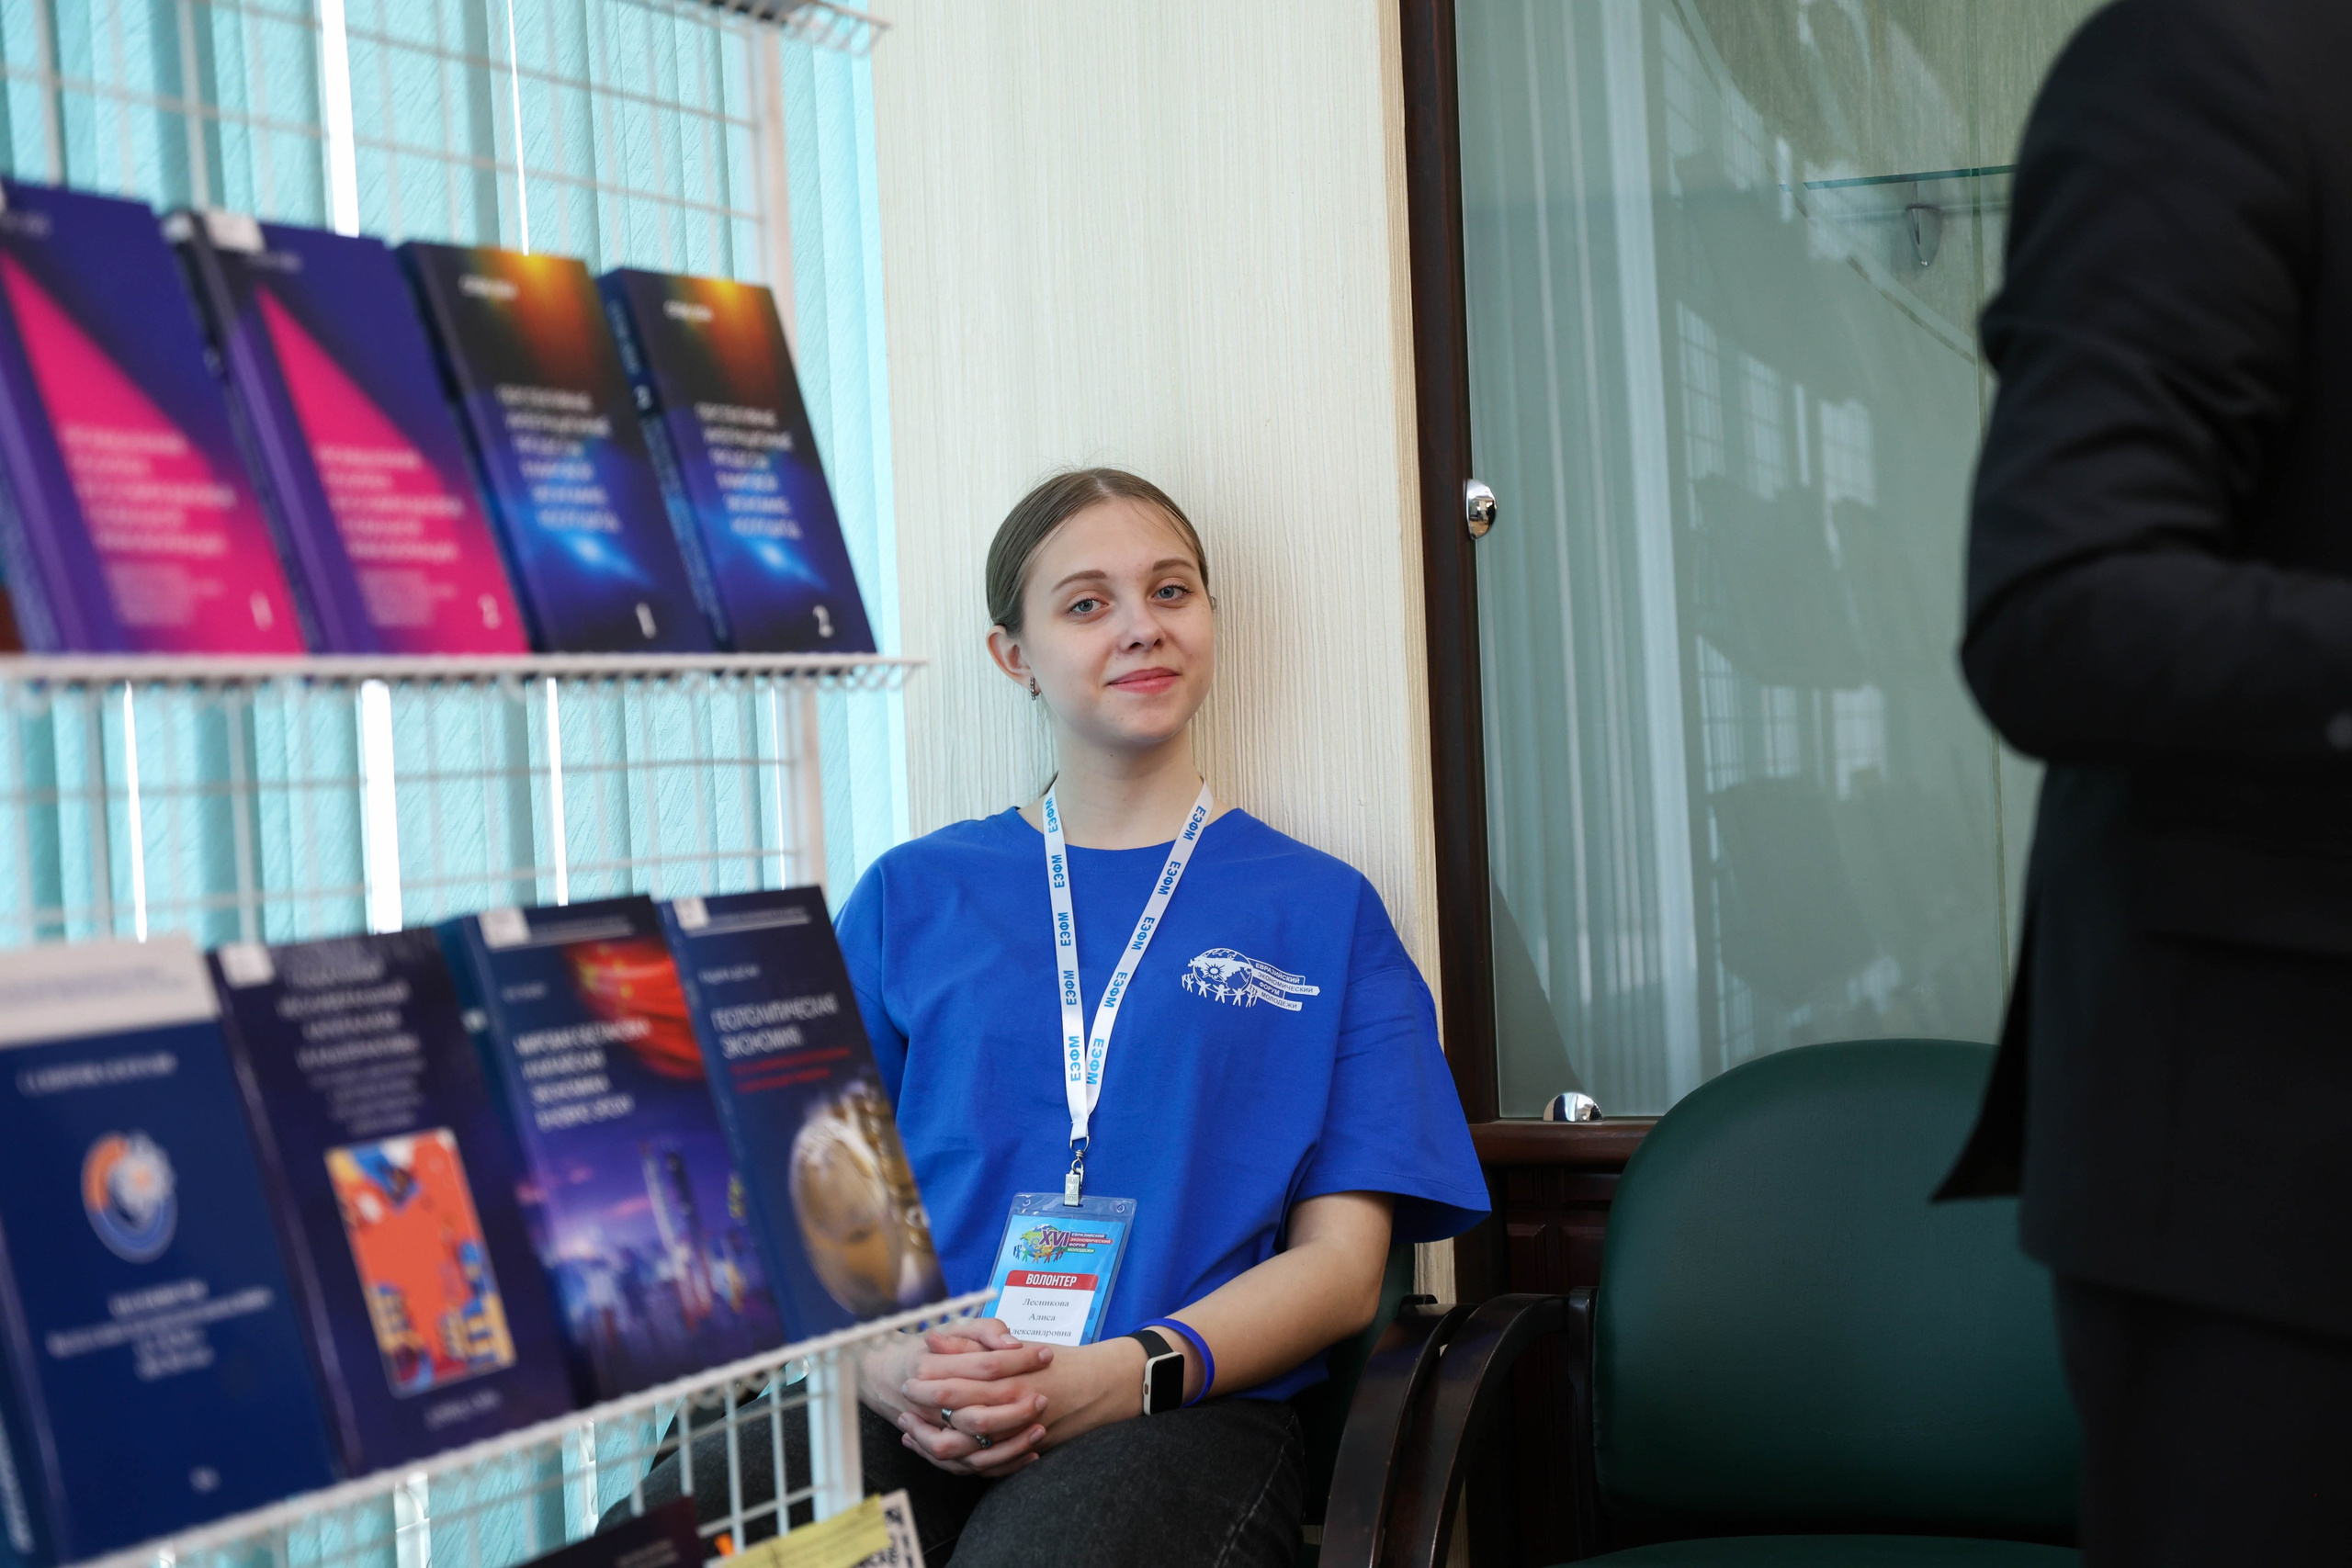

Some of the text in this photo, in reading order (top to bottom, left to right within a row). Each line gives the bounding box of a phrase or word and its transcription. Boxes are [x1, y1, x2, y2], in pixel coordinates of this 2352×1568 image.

[813, 604, 835, 637] 2
[1045, 796, 1058, 833] ЕЭФМ
[1183, 806, 1206, 840] ЕЭФМ
[1051, 854, 1065, 888] ЕЭФМ
[1158, 861, 1182, 895] ЕЭФМ
[1057, 912, 1071, 946] ЕЭФМ
[1131, 917, 1155, 950] ЕЭФМ
[1064, 970, 1077, 1005] ЕЭФМ
[1255, 963, 1300, 984] ЕВРАЗИЙСКИЙ
[1258, 972, 1313, 993] ЭКОНОМИЧЕСКИЙ
[1259, 982, 1281, 996] ФОРУМ
[1104, 972, 1128, 1009] ЕЭФМ
[1261, 992, 1297, 1010] МОЛОДЕЖИ
[1069, 1036, 1081, 1081] ЕЭФМ
[1086, 1038, 1105, 1085] ЕЭФМ
[1039, 1230, 1070, 1247] XVI
[1025, 1273, 1078, 1287] ВОЛОНТЕР
[1022, 1298, 1069, 1308] Лесникова
[1028, 1314, 1056, 1322] Алиса
